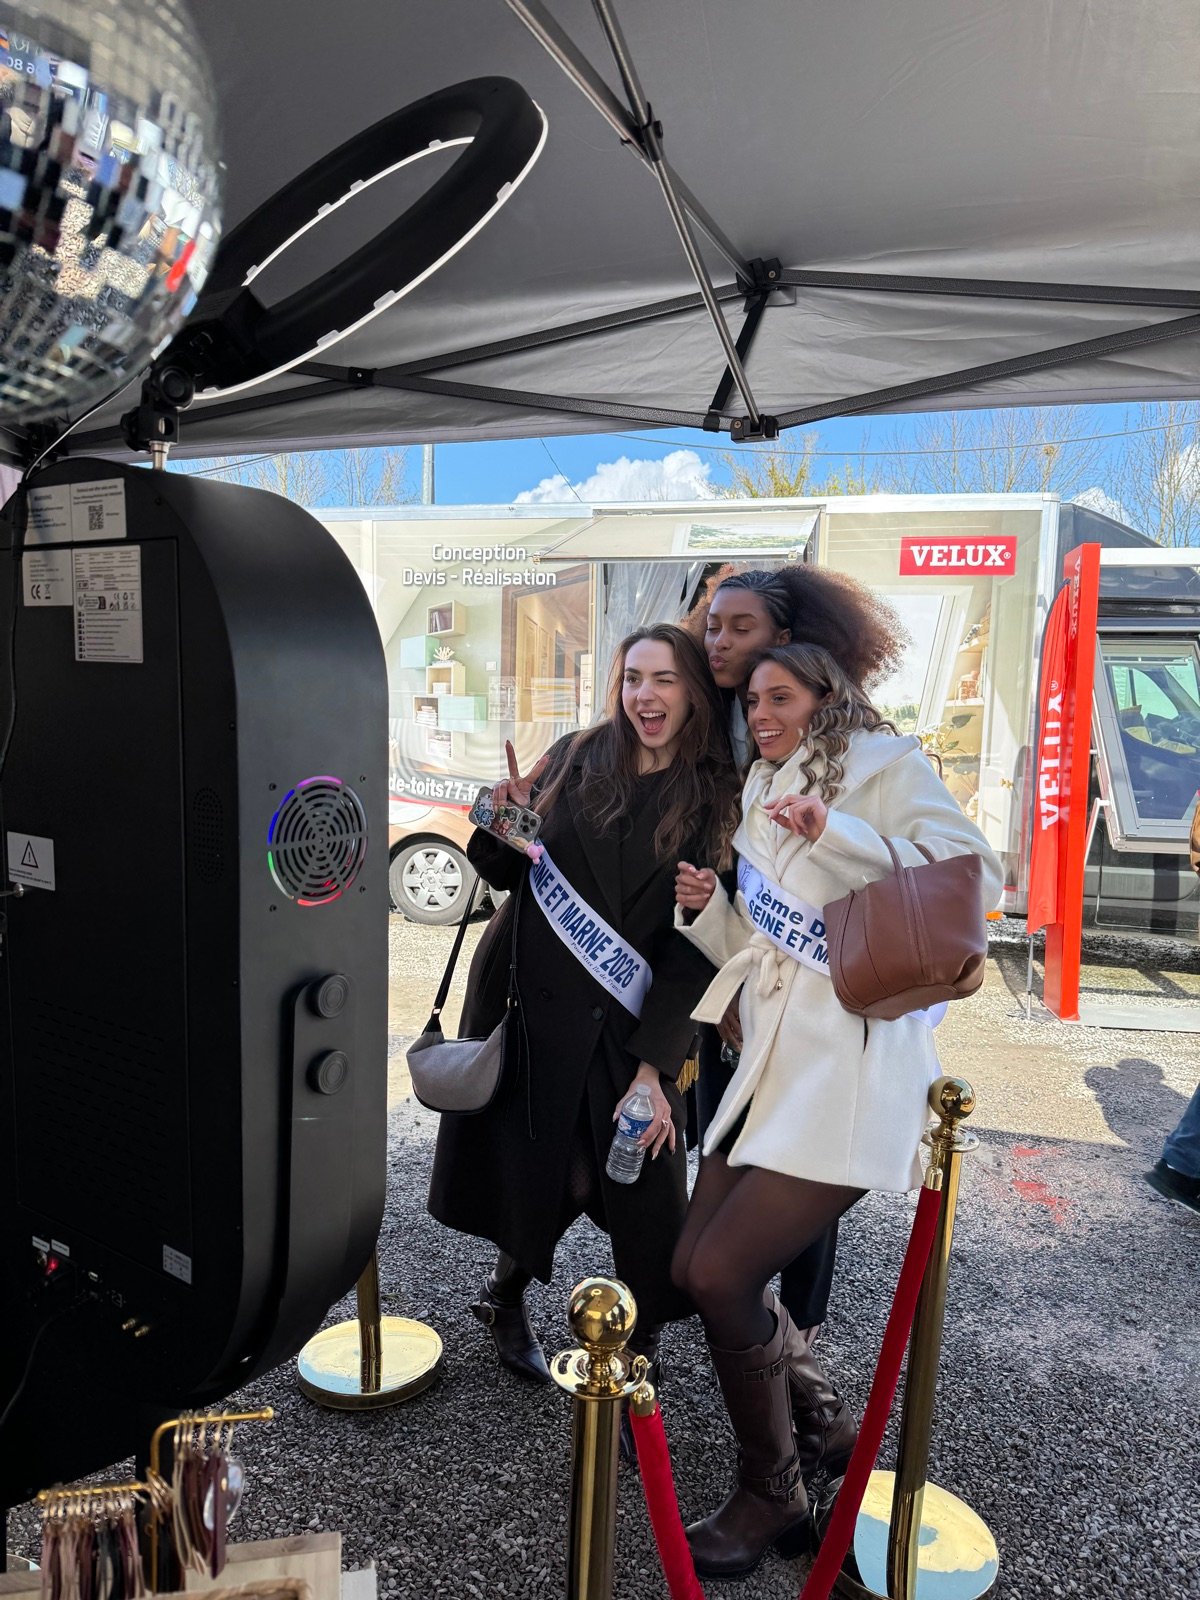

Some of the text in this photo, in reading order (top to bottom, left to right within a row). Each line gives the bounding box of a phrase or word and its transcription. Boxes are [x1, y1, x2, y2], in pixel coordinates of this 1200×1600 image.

[432, 543, 527, 564] Conception
[402, 568, 446, 585] Devis
[462, 567, 557, 585] Réalisation
[544, 883, 570, 913] ET
[557, 901, 614, 962] MARNE
[599, 946, 641, 989] 2026
[748, 899, 785, 939] SEINE
[786, 928, 813, 953] ET
